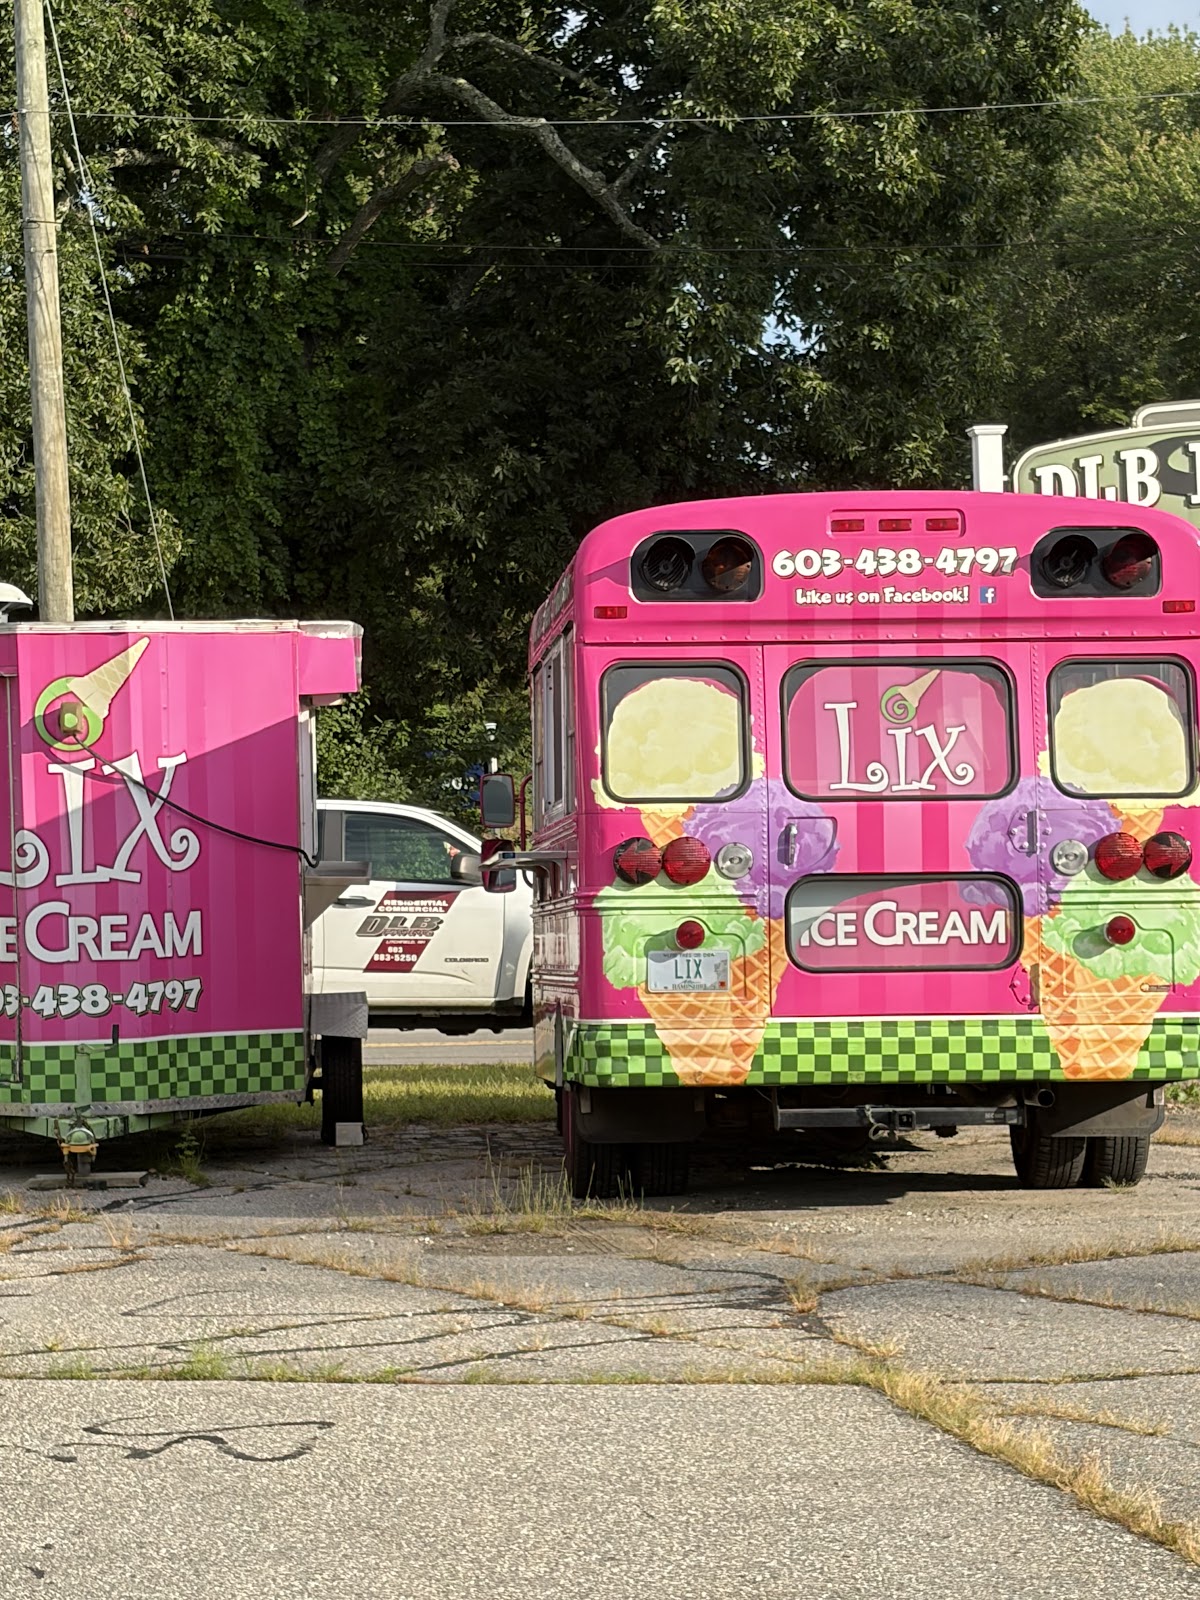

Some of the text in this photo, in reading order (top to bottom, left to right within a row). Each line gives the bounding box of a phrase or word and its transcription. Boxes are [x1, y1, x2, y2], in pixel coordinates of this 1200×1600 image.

[772, 547, 1018, 578] 603-438-4797
[795, 588, 831, 604] Like
[835, 591, 854, 604] us
[860, 591, 879, 603] on
[883, 586, 969, 604] Facebook!
[383, 899, 449, 907] RESIDENTIAL
[24, 901, 202, 963] CREAM
[355, 915, 444, 937] DLB
[863, 901, 1006, 946] CREAM
[675, 959, 702, 979] LIX
